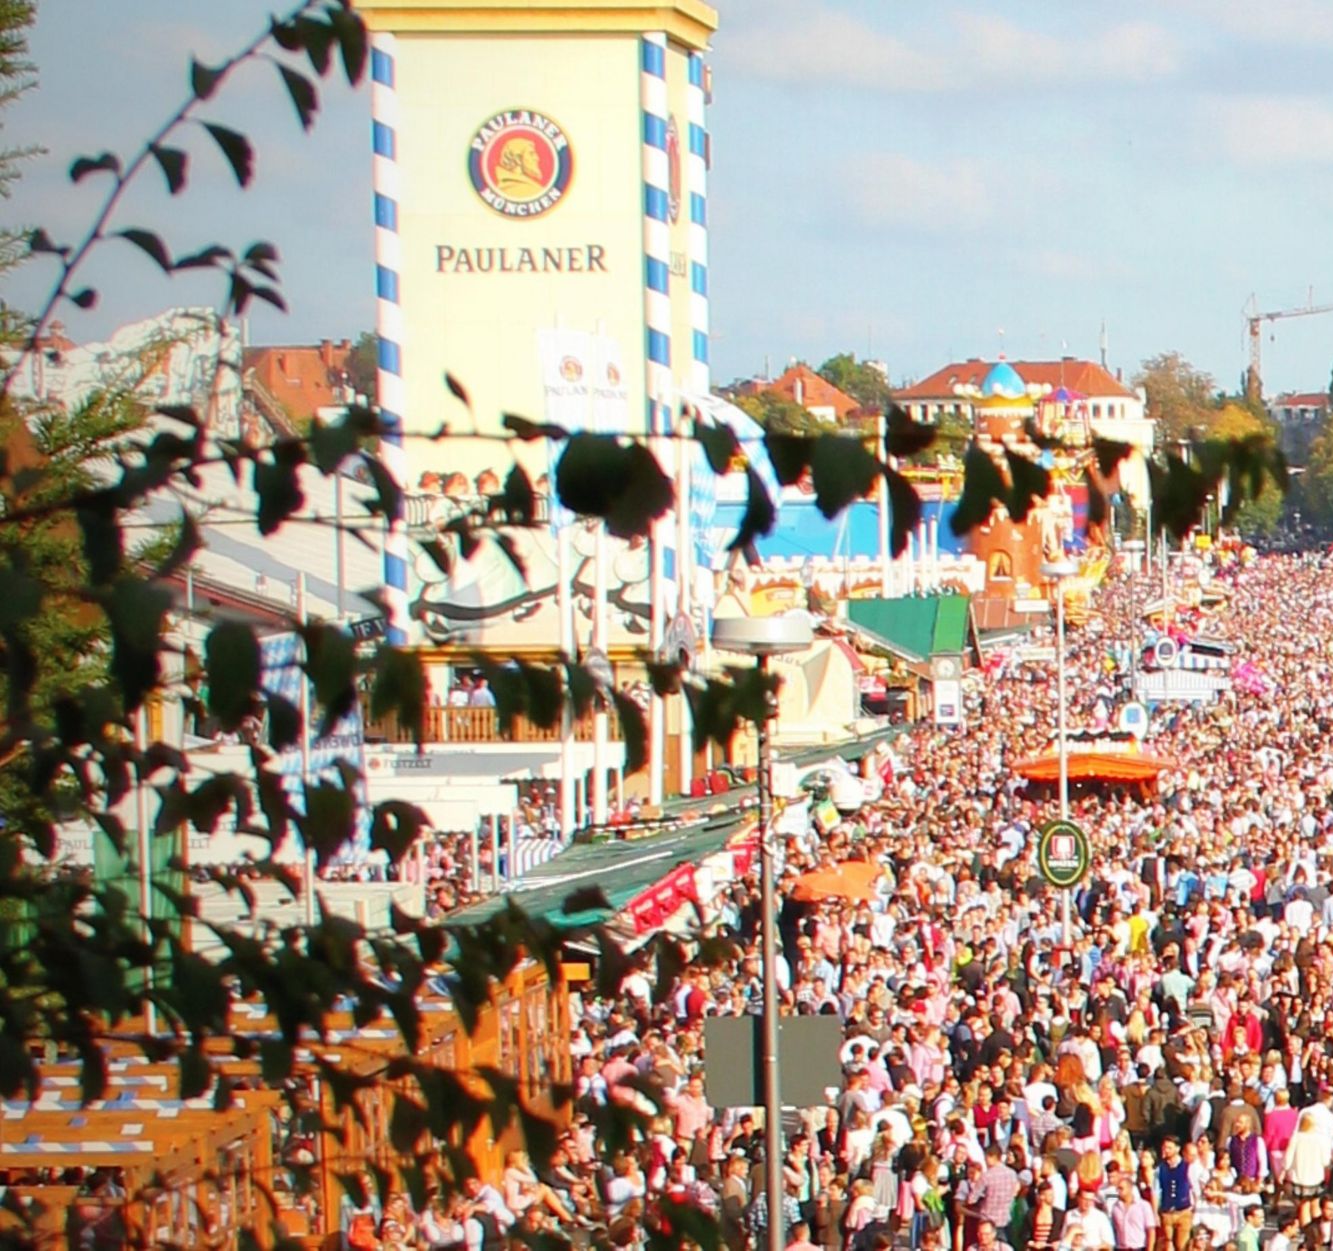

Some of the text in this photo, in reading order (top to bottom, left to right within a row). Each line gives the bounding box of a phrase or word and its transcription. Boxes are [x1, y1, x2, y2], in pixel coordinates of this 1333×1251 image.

[470, 110, 569, 153] PAULANER
[479, 187, 563, 217] MÜNCHEN
[434, 243, 609, 273] PAULANER
